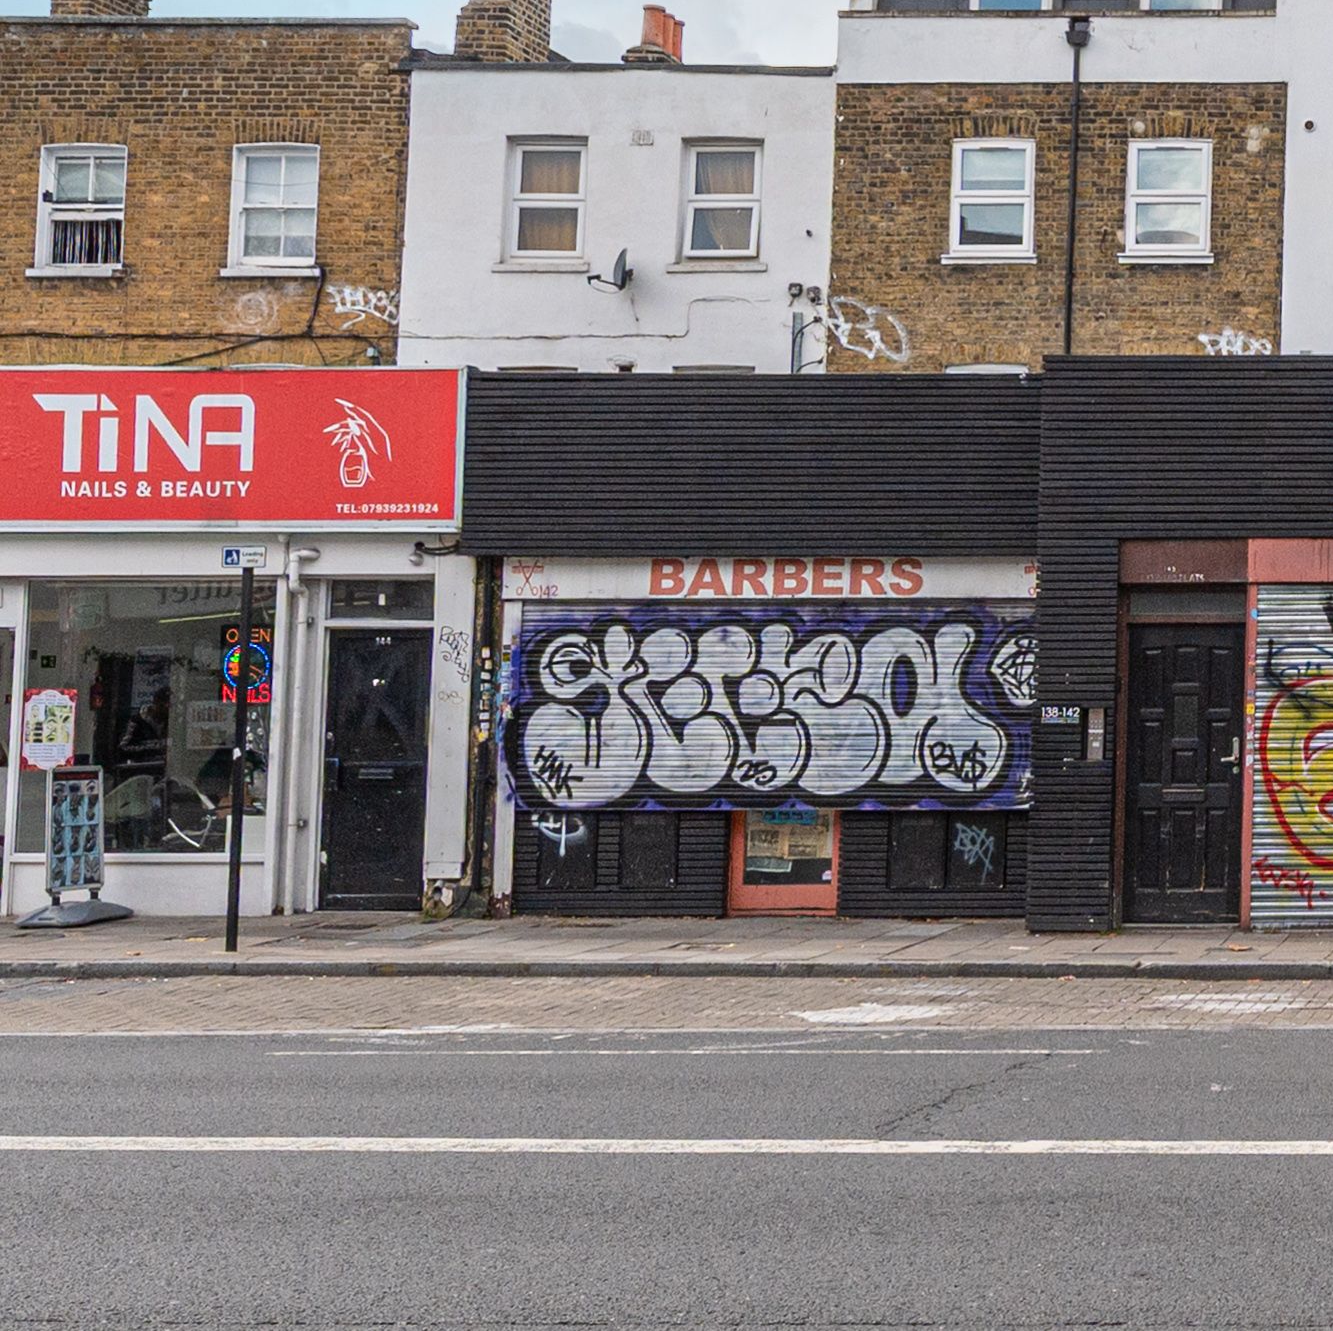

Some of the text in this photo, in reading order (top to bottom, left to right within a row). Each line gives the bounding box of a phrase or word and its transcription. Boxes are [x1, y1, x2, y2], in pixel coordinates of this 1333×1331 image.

[61, 480, 251, 497] NAILS & BEAUTY
[648, 557, 924, 596] BARBERS
[226, 628, 271, 643] OEN
[222, 682, 272, 704] NILS
[1041, 706, 1081, 718] 138-142
